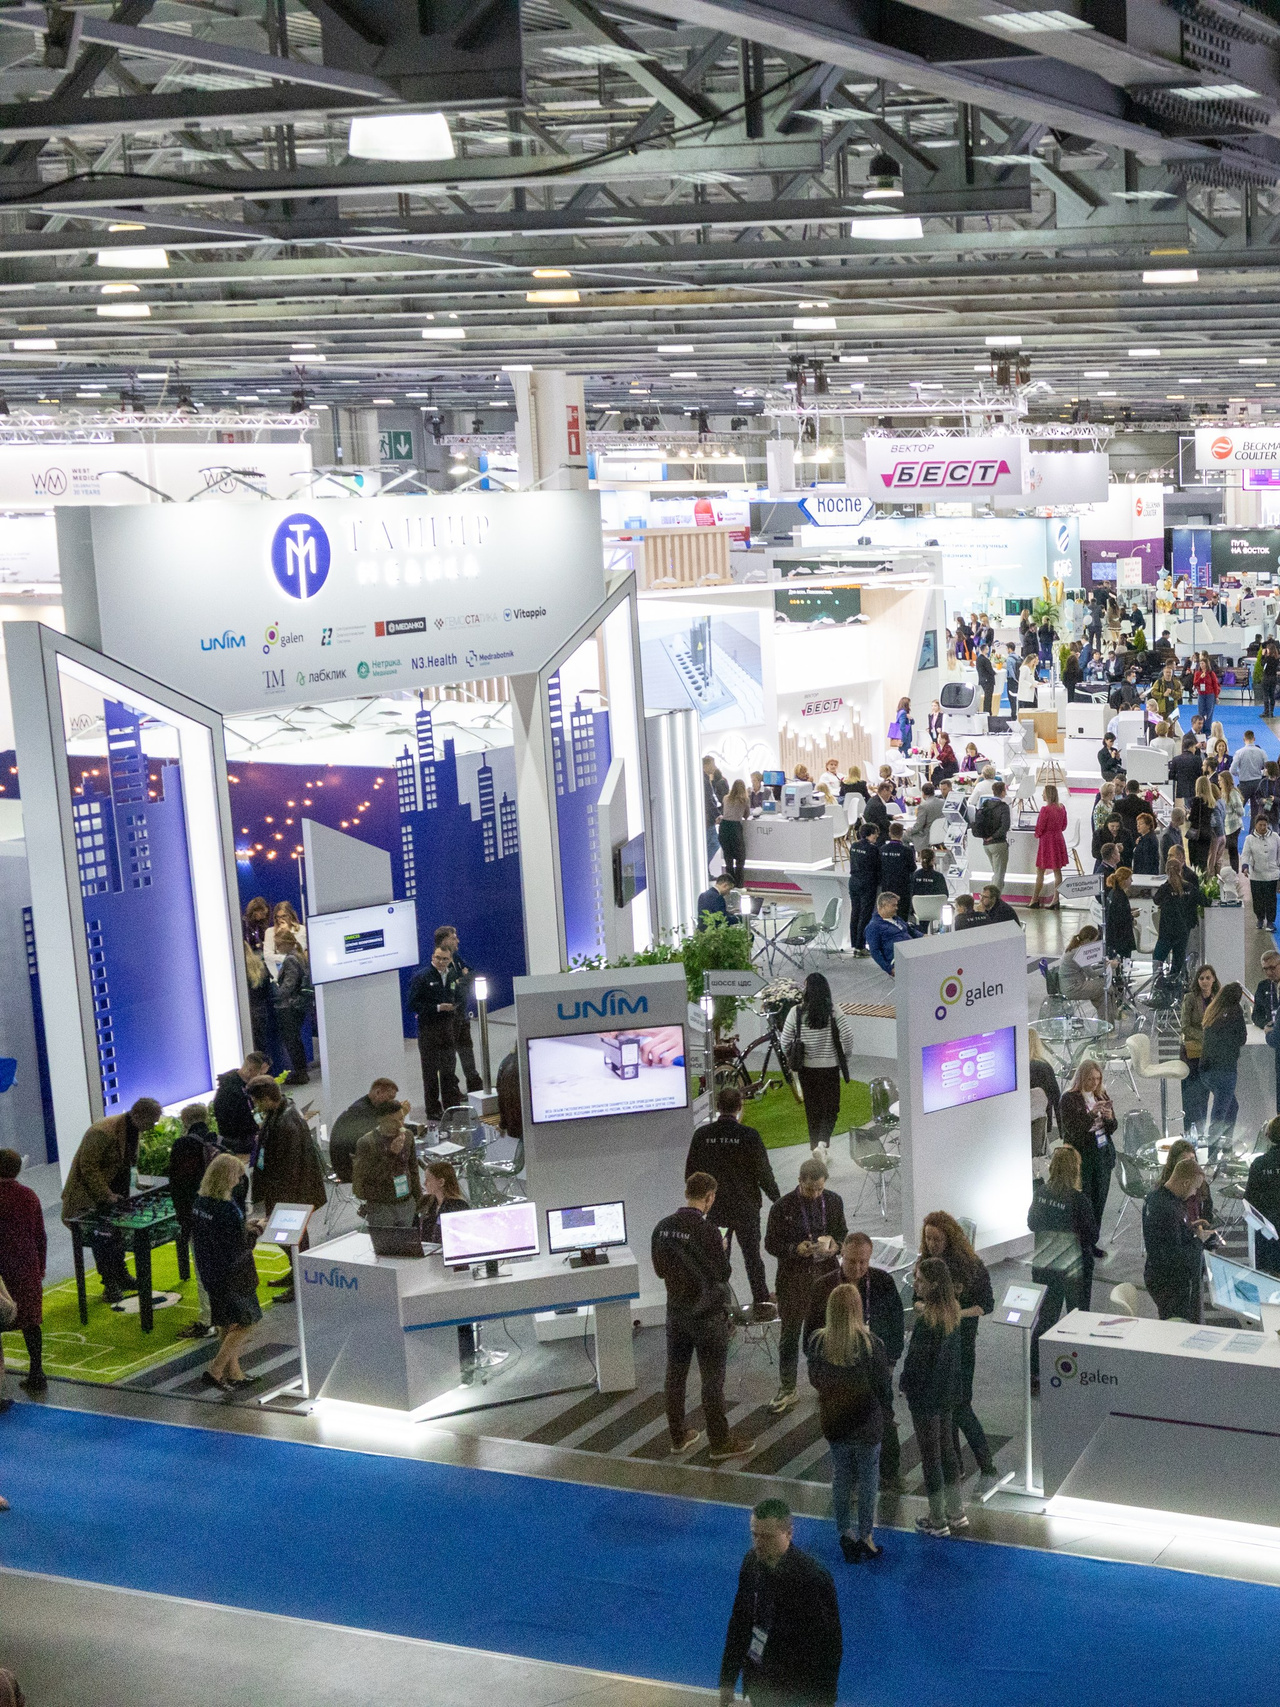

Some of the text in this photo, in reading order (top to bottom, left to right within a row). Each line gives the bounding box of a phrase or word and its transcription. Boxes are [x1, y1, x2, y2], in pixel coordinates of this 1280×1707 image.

[890, 444, 935, 453] ВЕКТОР
[1234, 451, 1278, 461] COULTER
[897, 464, 996, 483] БЕСТ
[1231, 539, 1250, 547] ПУТЬ
[513, 606, 547, 620] Vitappio
[200, 630, 246, 651] UNIM
[280, 632, 304, 648] galen
[411, 652, 458, 670] N3.Health
[308, 668, 347, 684] лабклик
[806, 700, 839, 714] БЕСТ
[756, 826, 773, 836] ПЦР
[1065, 879, 1099, 888] ФУТБОЛЬНЫЙ
[965, 981, 1004, 1007] galen
[557, 989, 649, 1020] UNIM
[672, 1231, 690, 1239] TEAM
[304, 1267, 359, 1291] UNIM
[1079, 1369, 1119, 1386] galen
